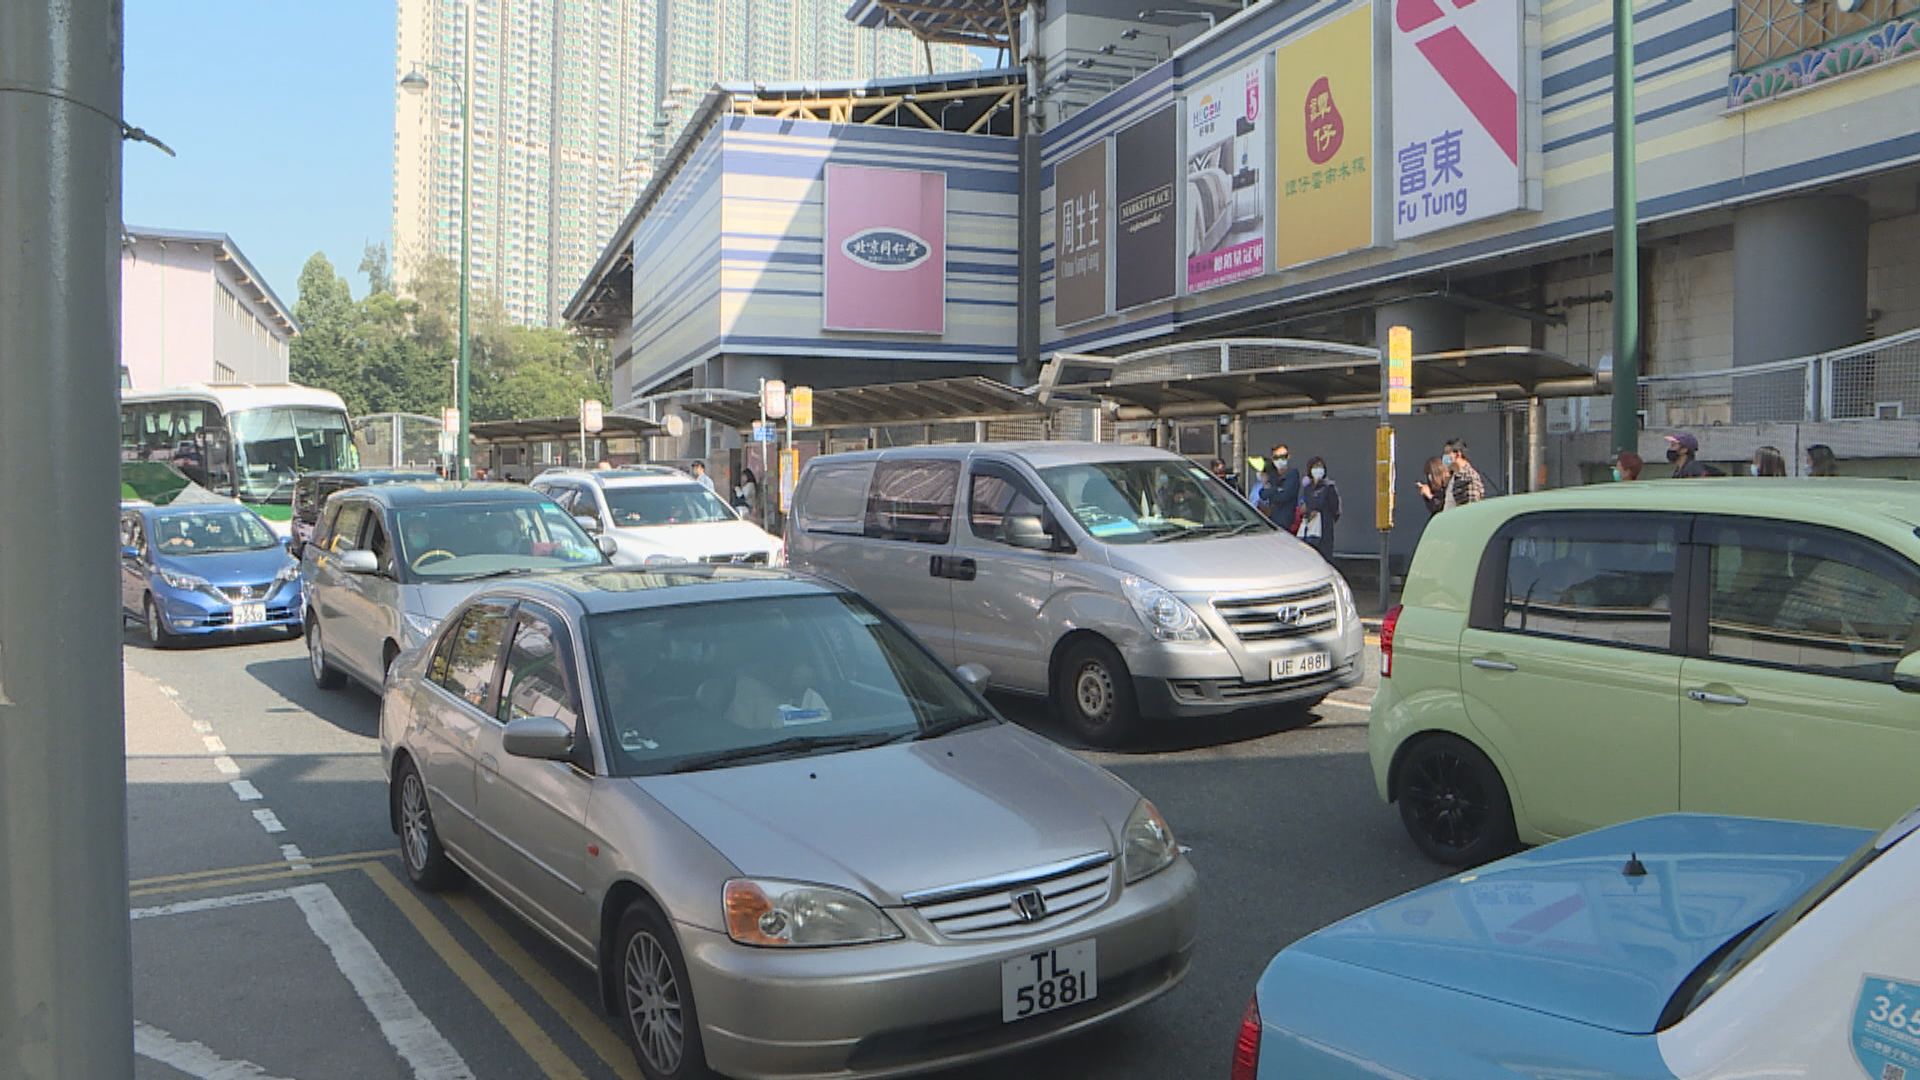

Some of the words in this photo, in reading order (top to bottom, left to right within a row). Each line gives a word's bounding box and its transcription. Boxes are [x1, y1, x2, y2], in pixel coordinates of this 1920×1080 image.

[1399, 129, 1463, 195] 富東
[1061, 189, 1099, 256] 周生生
[1399, 200, 1417, 225] Fu
[1422, 188, 1467, 216] Tung
[1300, 654, 1326, 671] 4881
[1031, 949, 1069, 982] TL
[1017, 970, 1086, 1015] 5881
